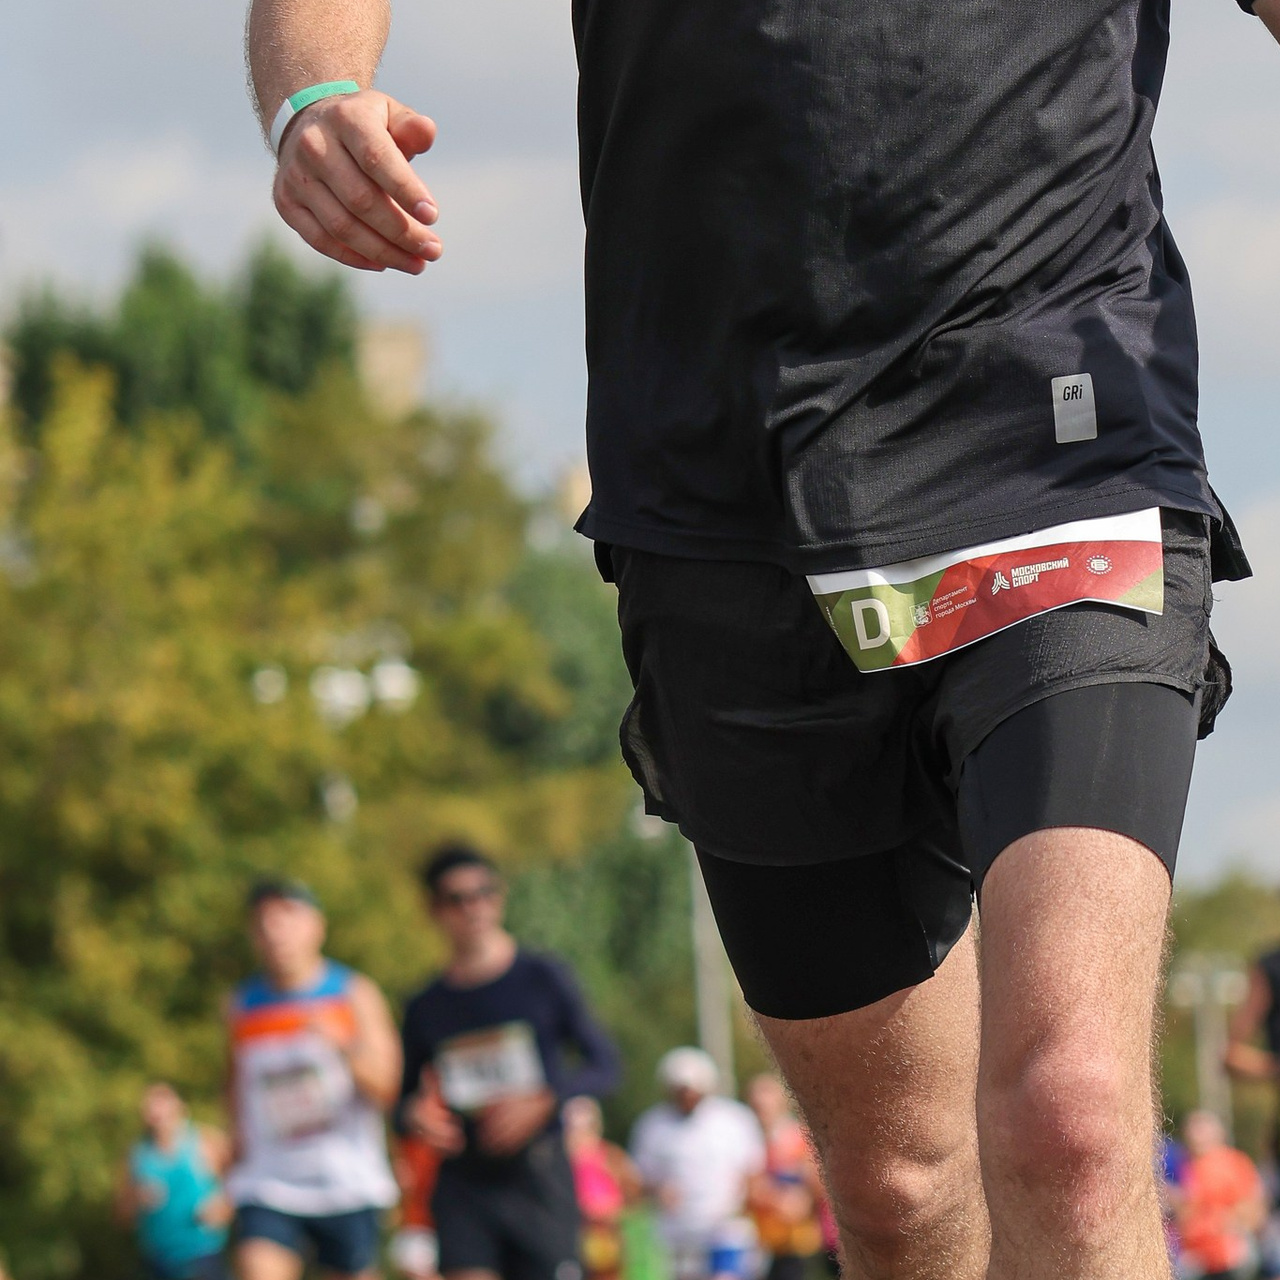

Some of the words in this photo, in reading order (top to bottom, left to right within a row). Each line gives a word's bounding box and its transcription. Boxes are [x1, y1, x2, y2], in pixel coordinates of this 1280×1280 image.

[1062, 384, 1083, 401] GRi
[1010, 557, 1070, 578] МОСКОВСКИЙ
[1012, 573, 1040, 588] СПОРТ
[932, 586, 968, 606] Департамент
[933, 600, 953, 612] спорта
[935, 608, 955, 619] города
[954, 597, 977, 611] Москвы
[850, 597, 891, 651] D
